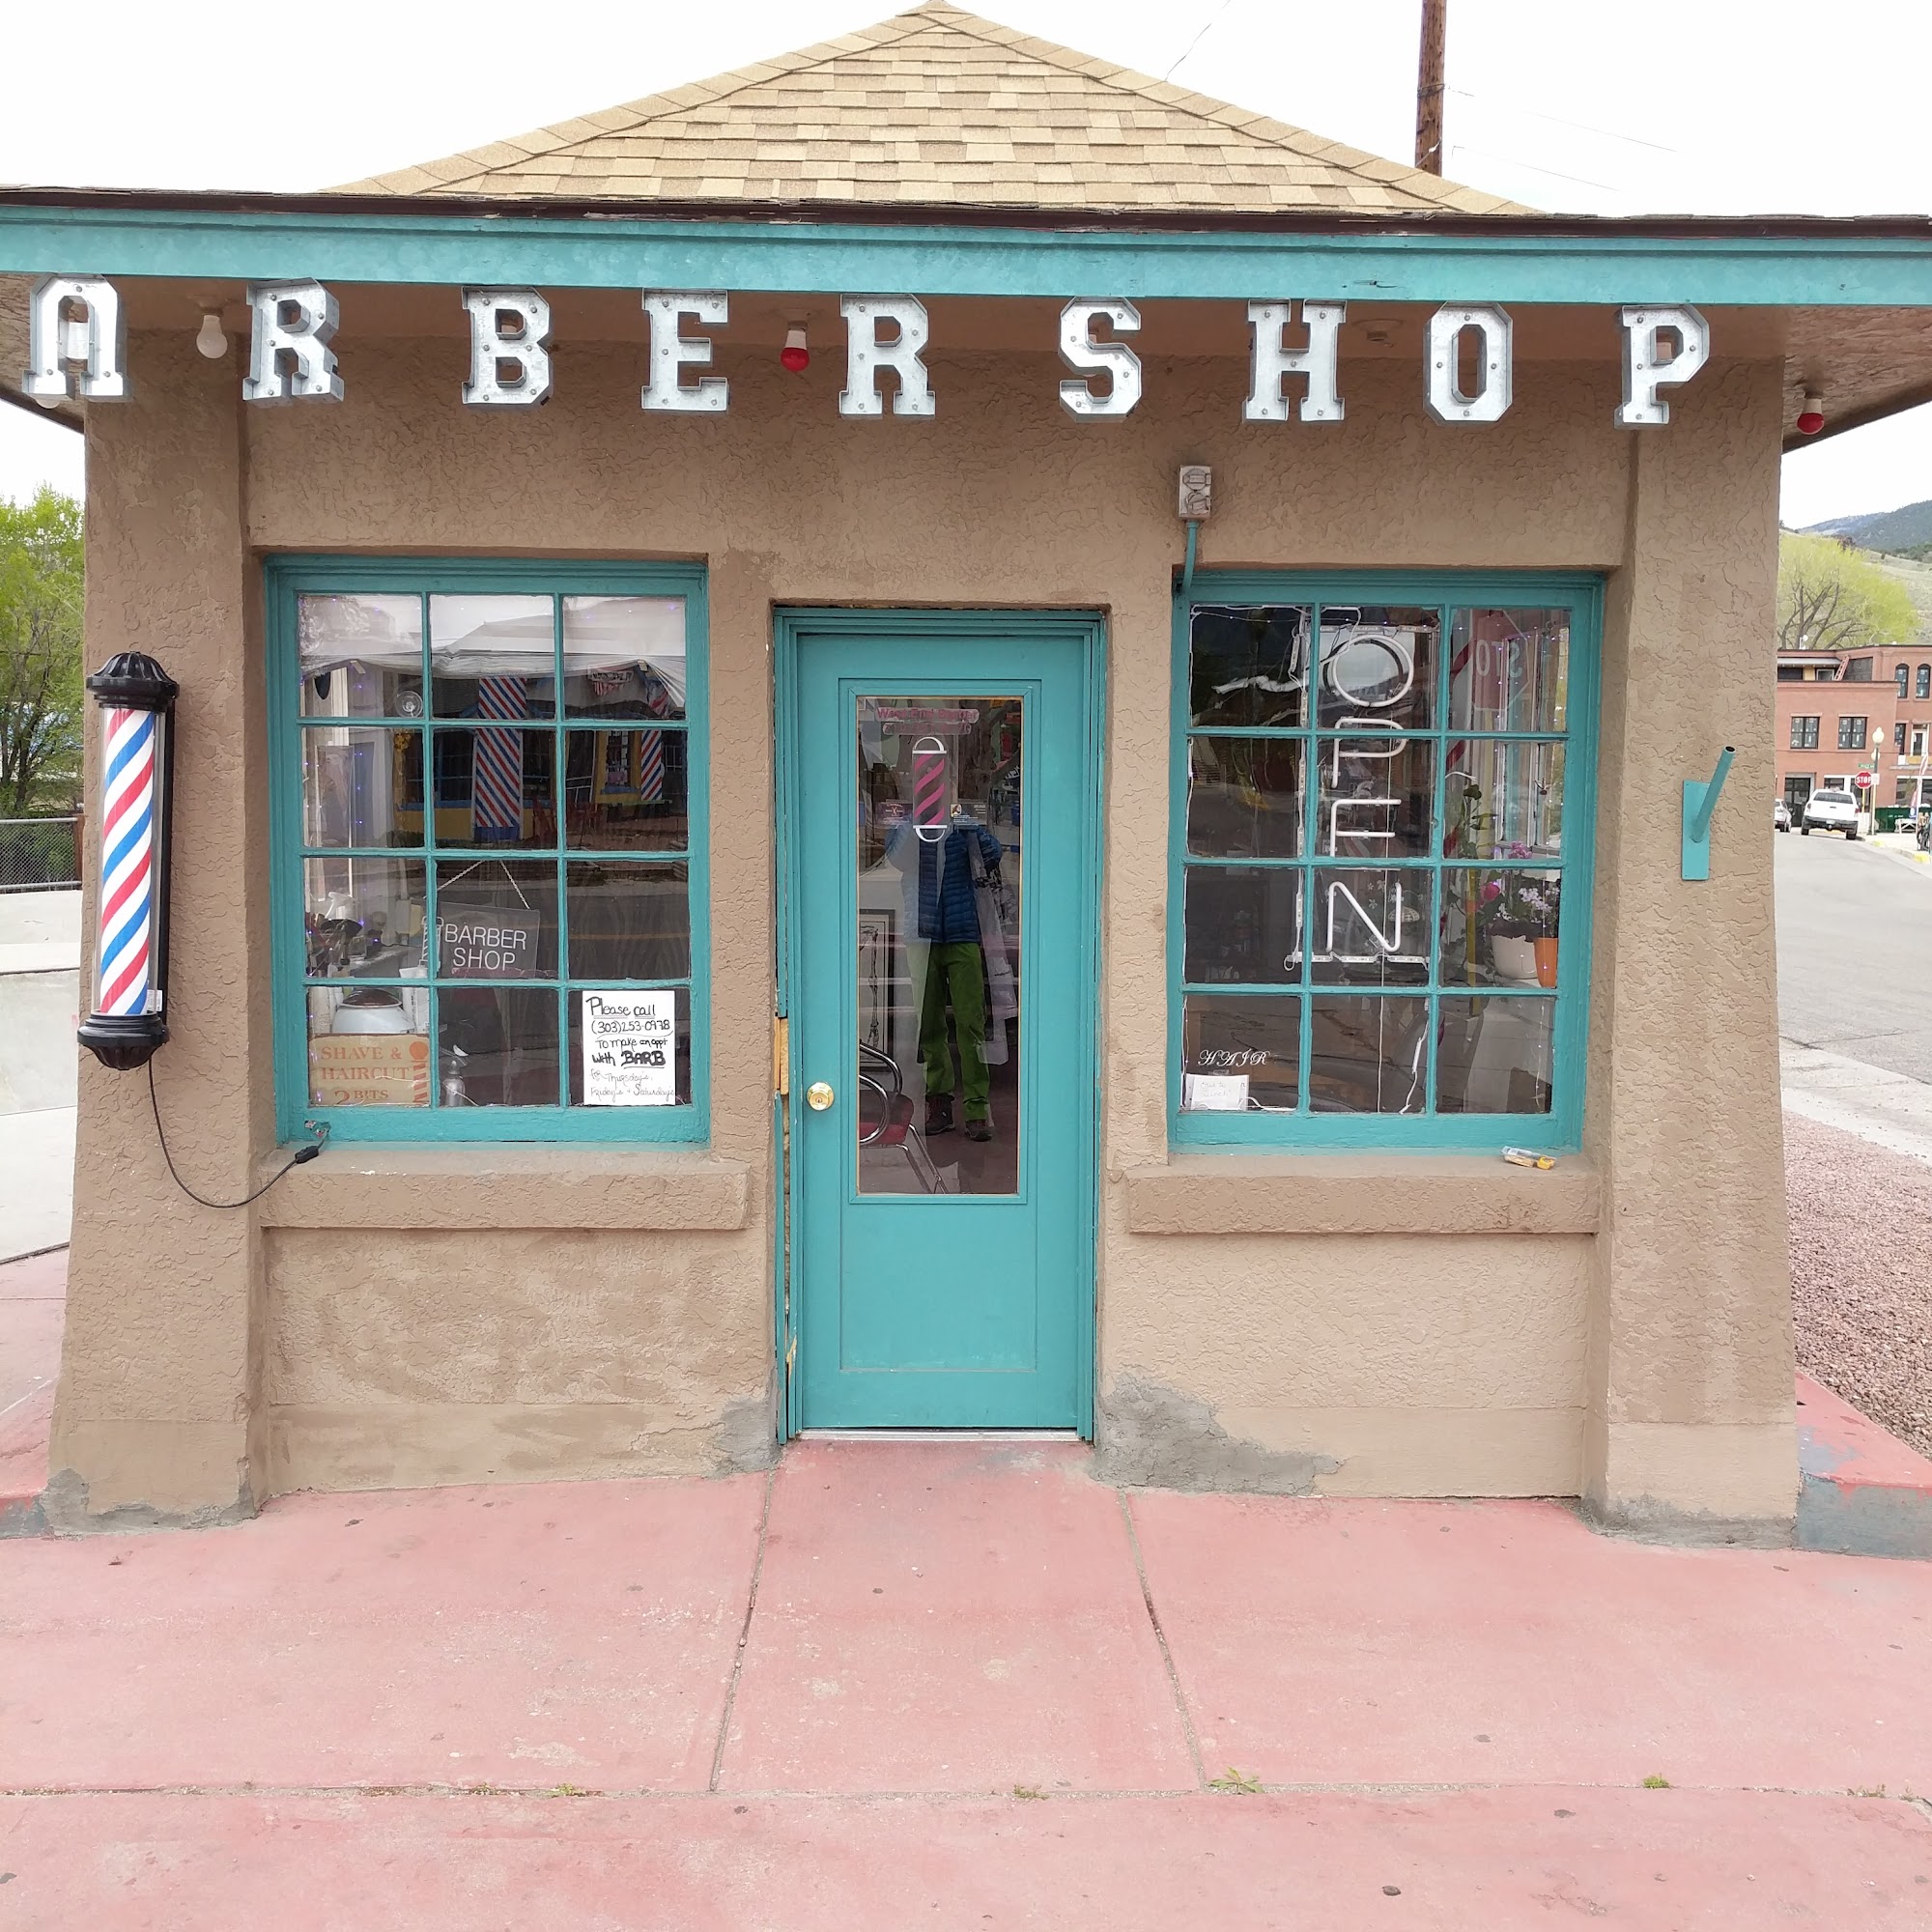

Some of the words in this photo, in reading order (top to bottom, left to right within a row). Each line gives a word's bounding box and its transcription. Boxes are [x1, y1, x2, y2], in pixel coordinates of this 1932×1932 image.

[1326, 634, 1415, 952] OPEN
[444, 923, 527, 951] BARBER
[452, 947, 516, 972] SHOP
[585, 996, 631, 1016] Please
[633, 1005, 656, 1016] call
[321, 1046, 384, 1061] SHAVE
[390, 1047, 402, 1061] &
[620, 1050, 667, 1067] BARB
[321, 1066, 410, 1080] HAIRCUT
[333, 1090, 351, 1105] 2
[354, 1090, 389, 1099] BITS
